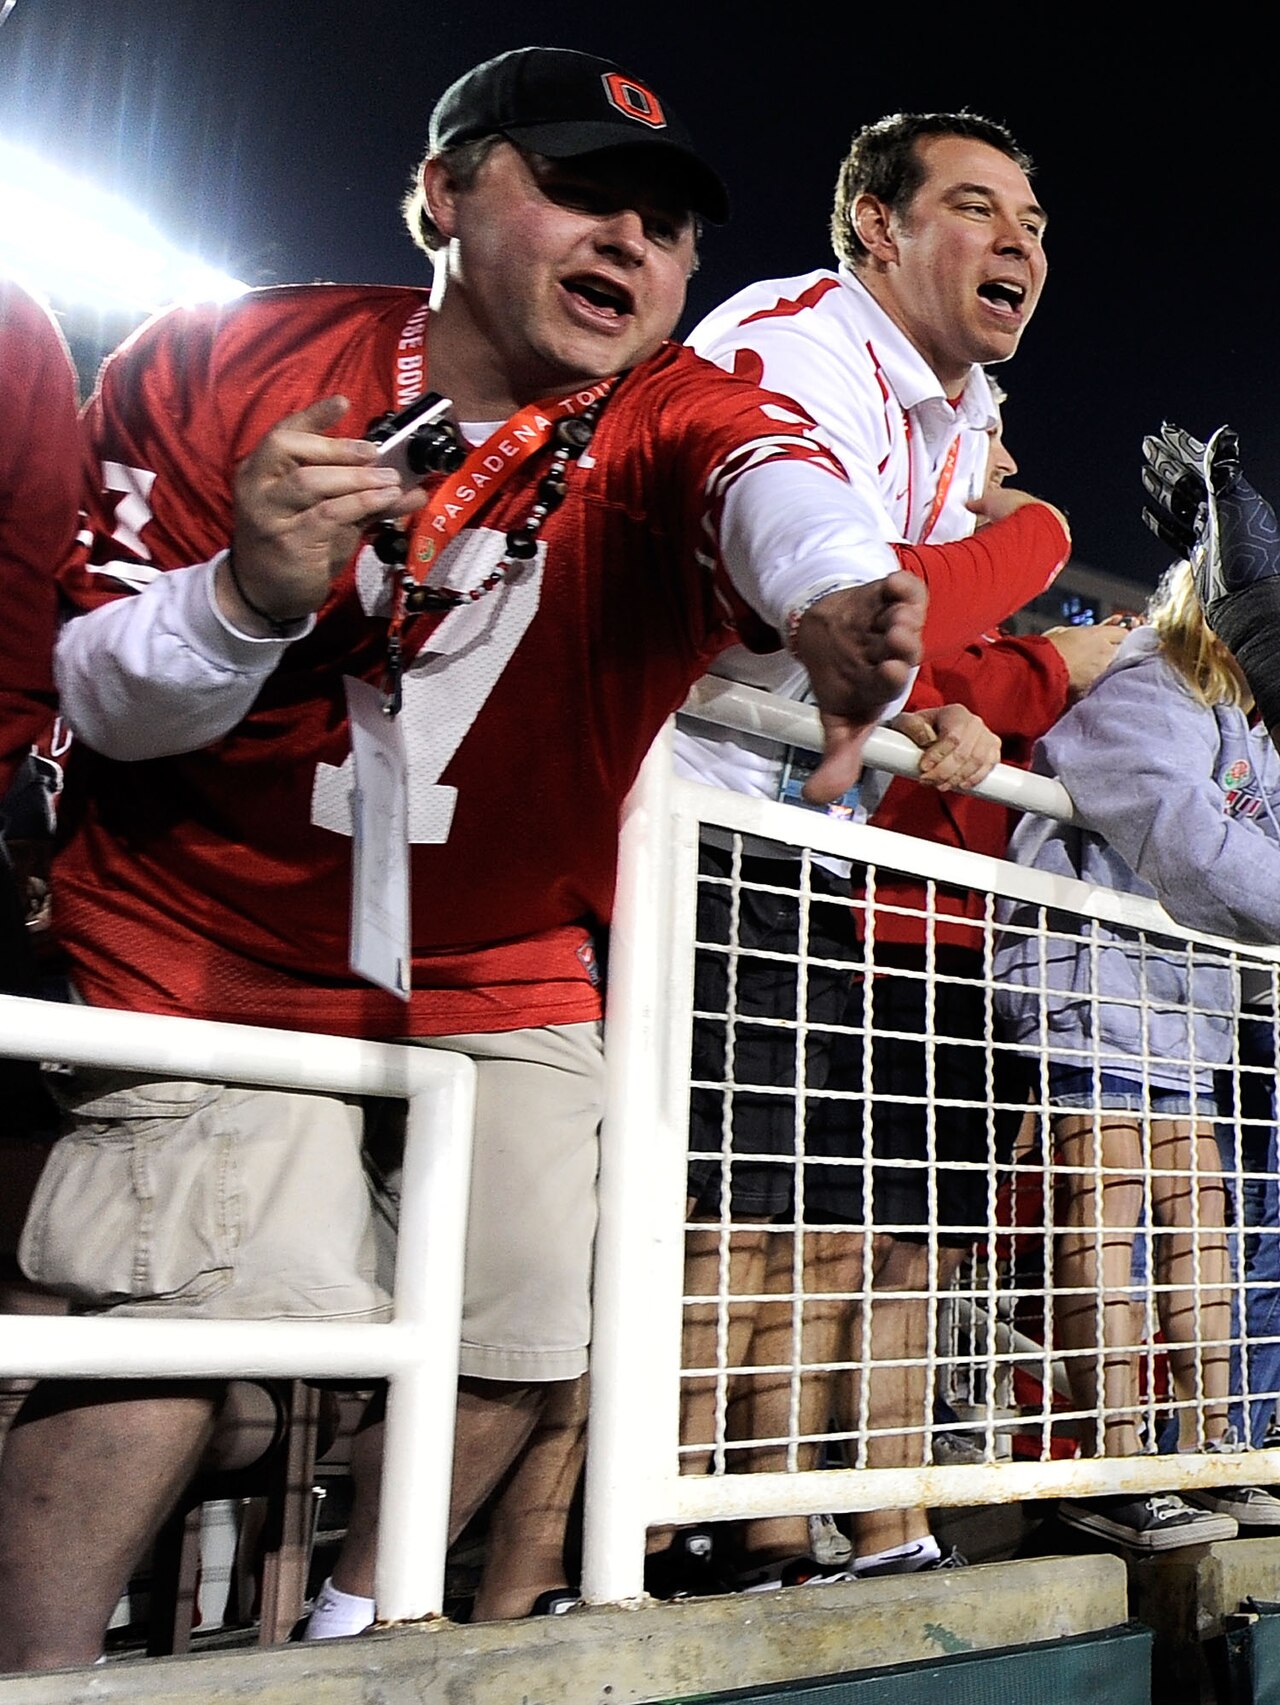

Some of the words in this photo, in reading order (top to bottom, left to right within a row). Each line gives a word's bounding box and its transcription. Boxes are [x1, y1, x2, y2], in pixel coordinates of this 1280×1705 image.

[600, 72, 668, 130] O
[397, 304, 431, 350] OSE
[397, 354, 424, 406] BOW
[431, 415, 553, 532] PASADENA
[557, 376, 621, 414] TOU
